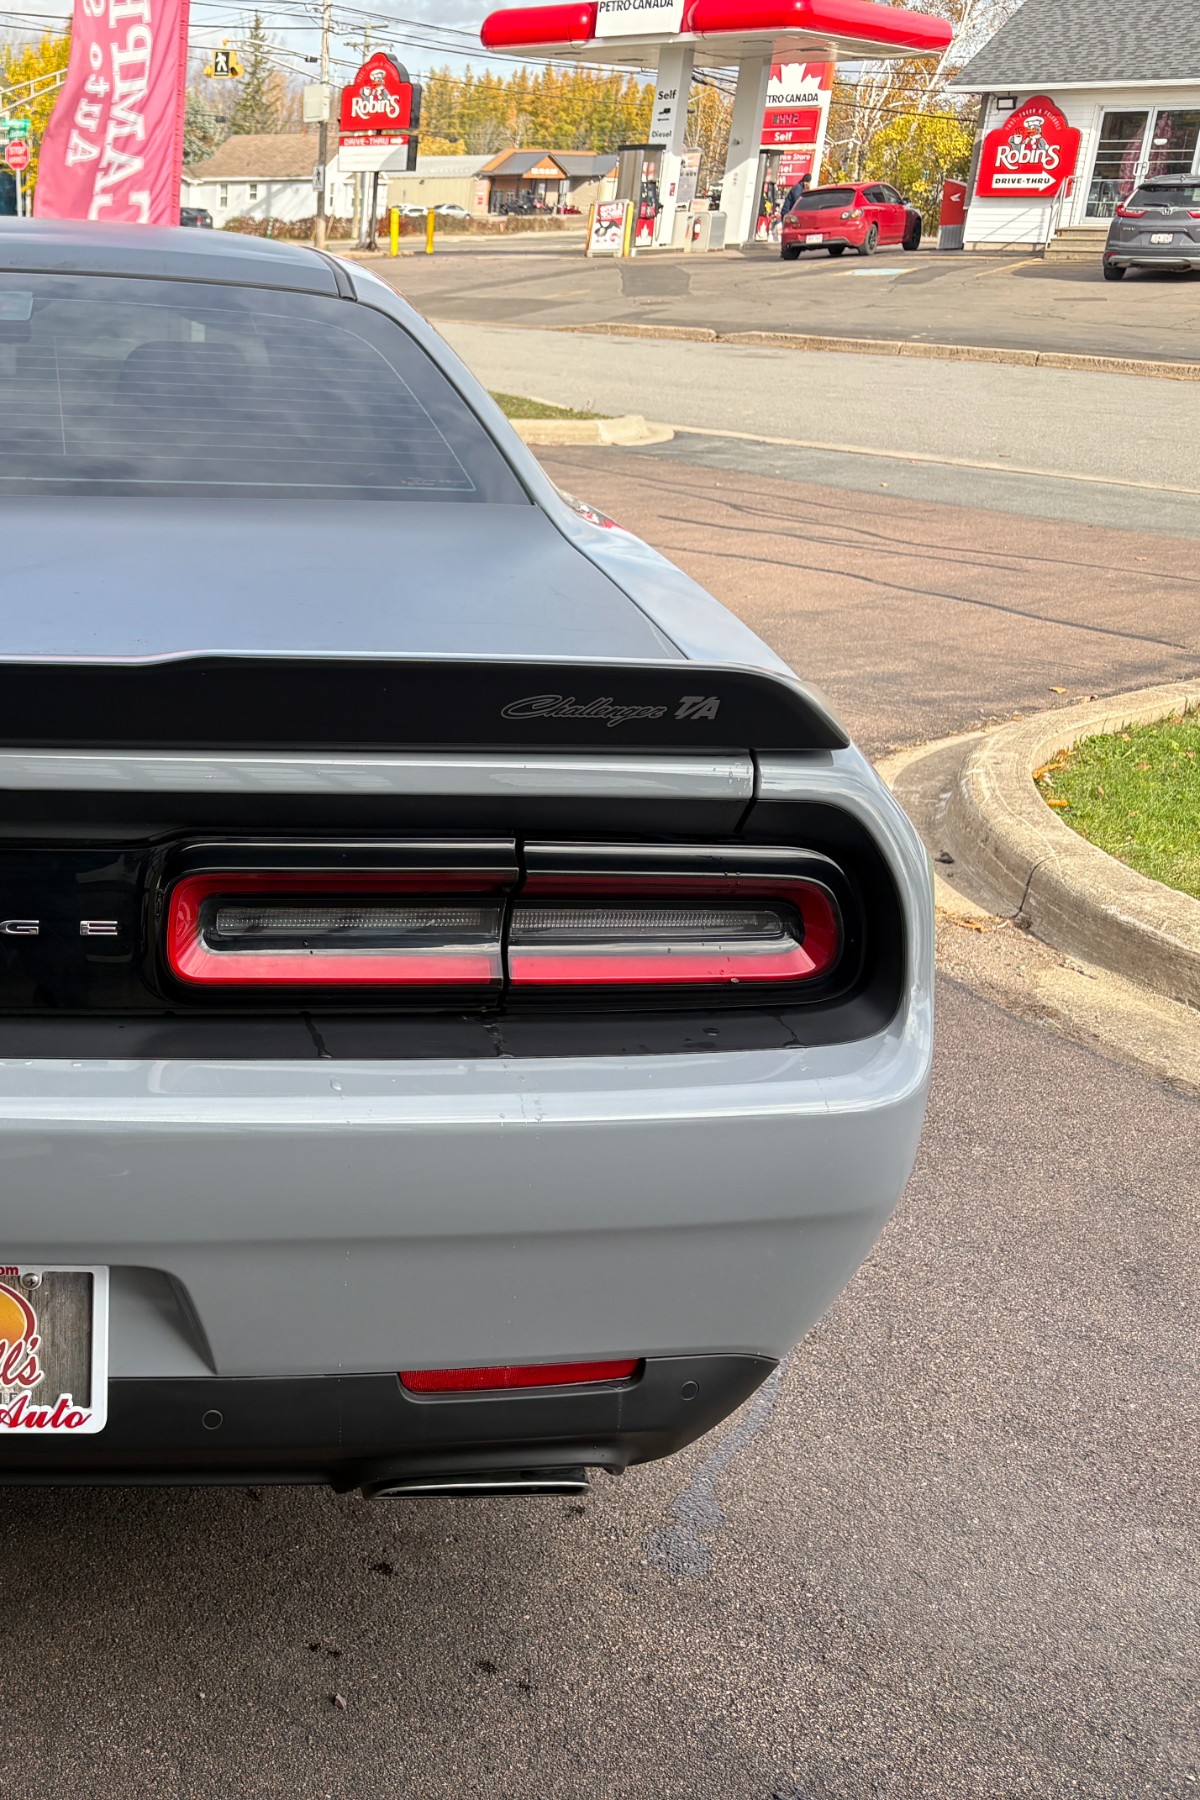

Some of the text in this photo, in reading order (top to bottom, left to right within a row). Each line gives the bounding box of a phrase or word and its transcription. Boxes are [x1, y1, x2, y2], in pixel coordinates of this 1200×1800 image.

[658, 89, 677, 100] Self
[774, 132, 793, 141] Self
[500, 694, 668, 728] Challenger
